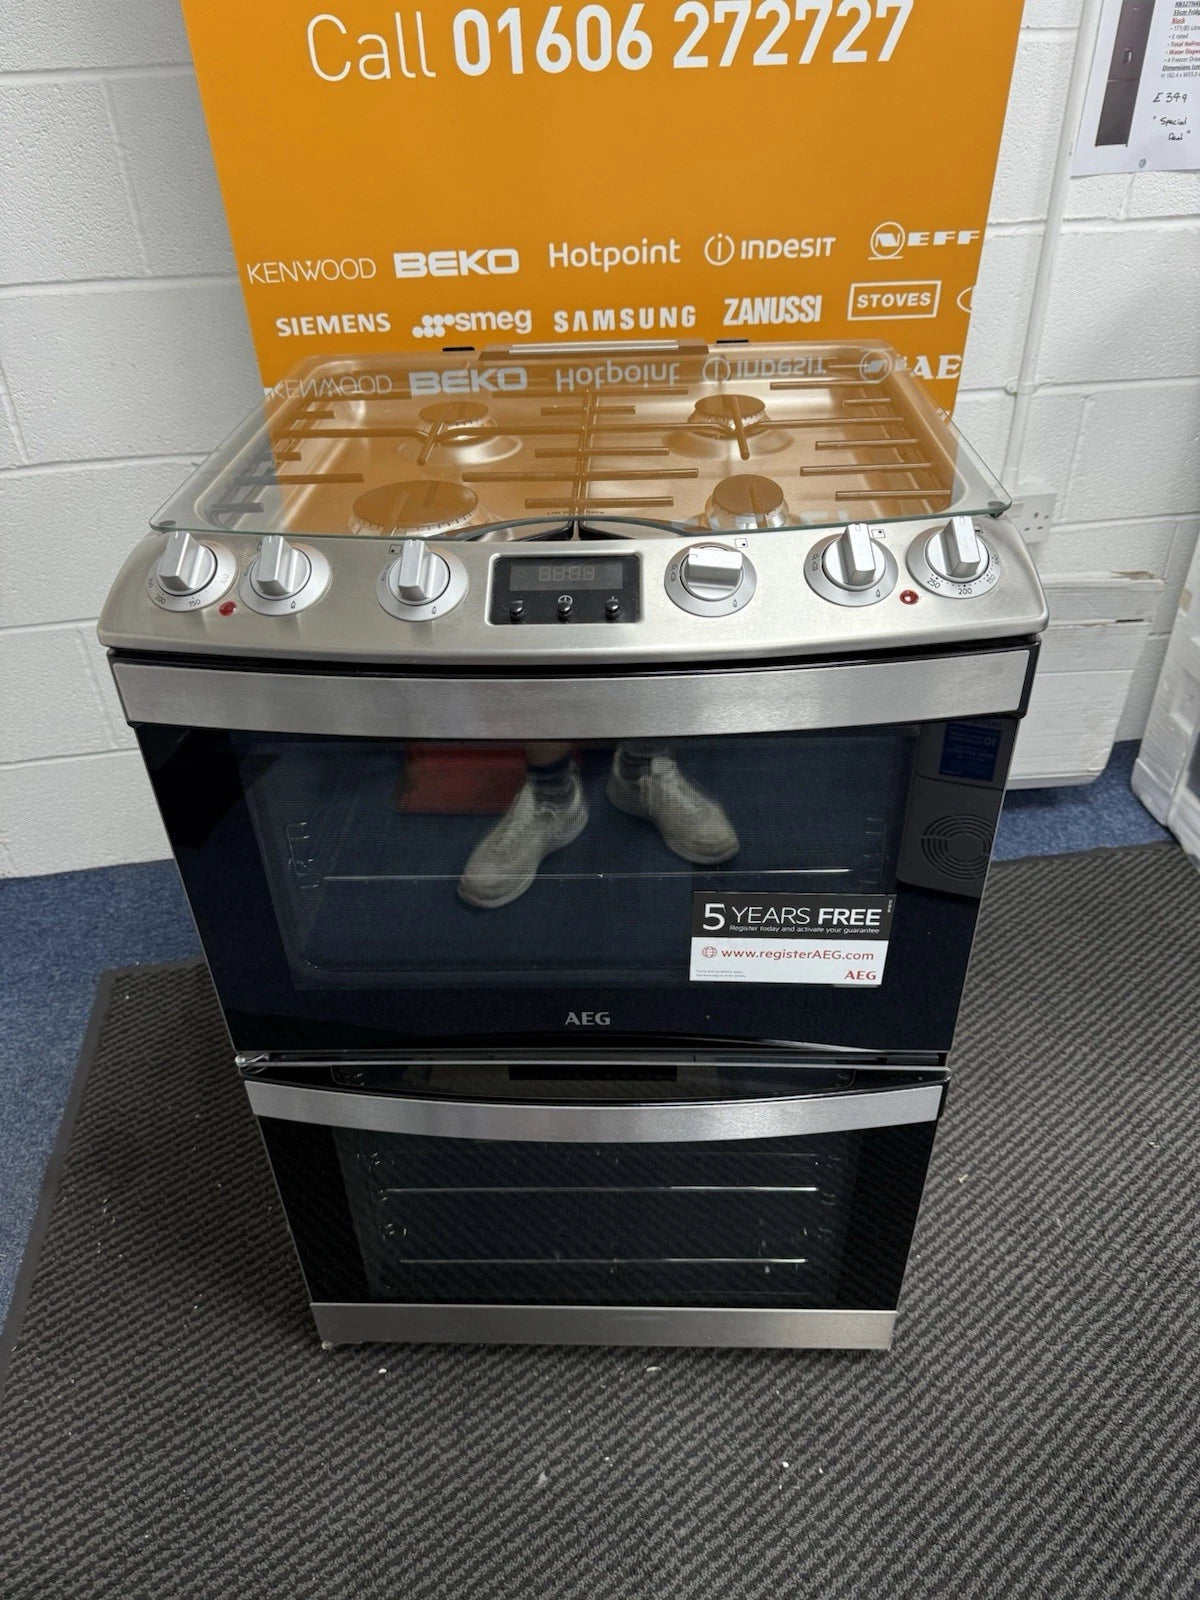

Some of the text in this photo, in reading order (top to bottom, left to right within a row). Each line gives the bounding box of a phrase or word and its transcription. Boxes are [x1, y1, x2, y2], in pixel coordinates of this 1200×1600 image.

[307, 0, 914, 82] Call 01606 272727
[247, 257, 377, 284] KENWOOD
[393, 248, 520, 278] BEKO
[549, 238, 681, 272] Hotpoint
[871, 225, 980, 252] NEFF
[275, 292, 931, 337] SIEMENS smeg SAMSUNG ZANUSSI STOVES
[927, 577, 941, 588] 250
[958, 587, 973, 595] 200
[703, 903, 882, 931] 5 YEARS FREE
[796, 925, 825, 933] activate
[721, 949, 874, 961] www.registerAEG.com
[844, 970, 876, 980] AEG
[565, 1012, 611, 1026] AEG
